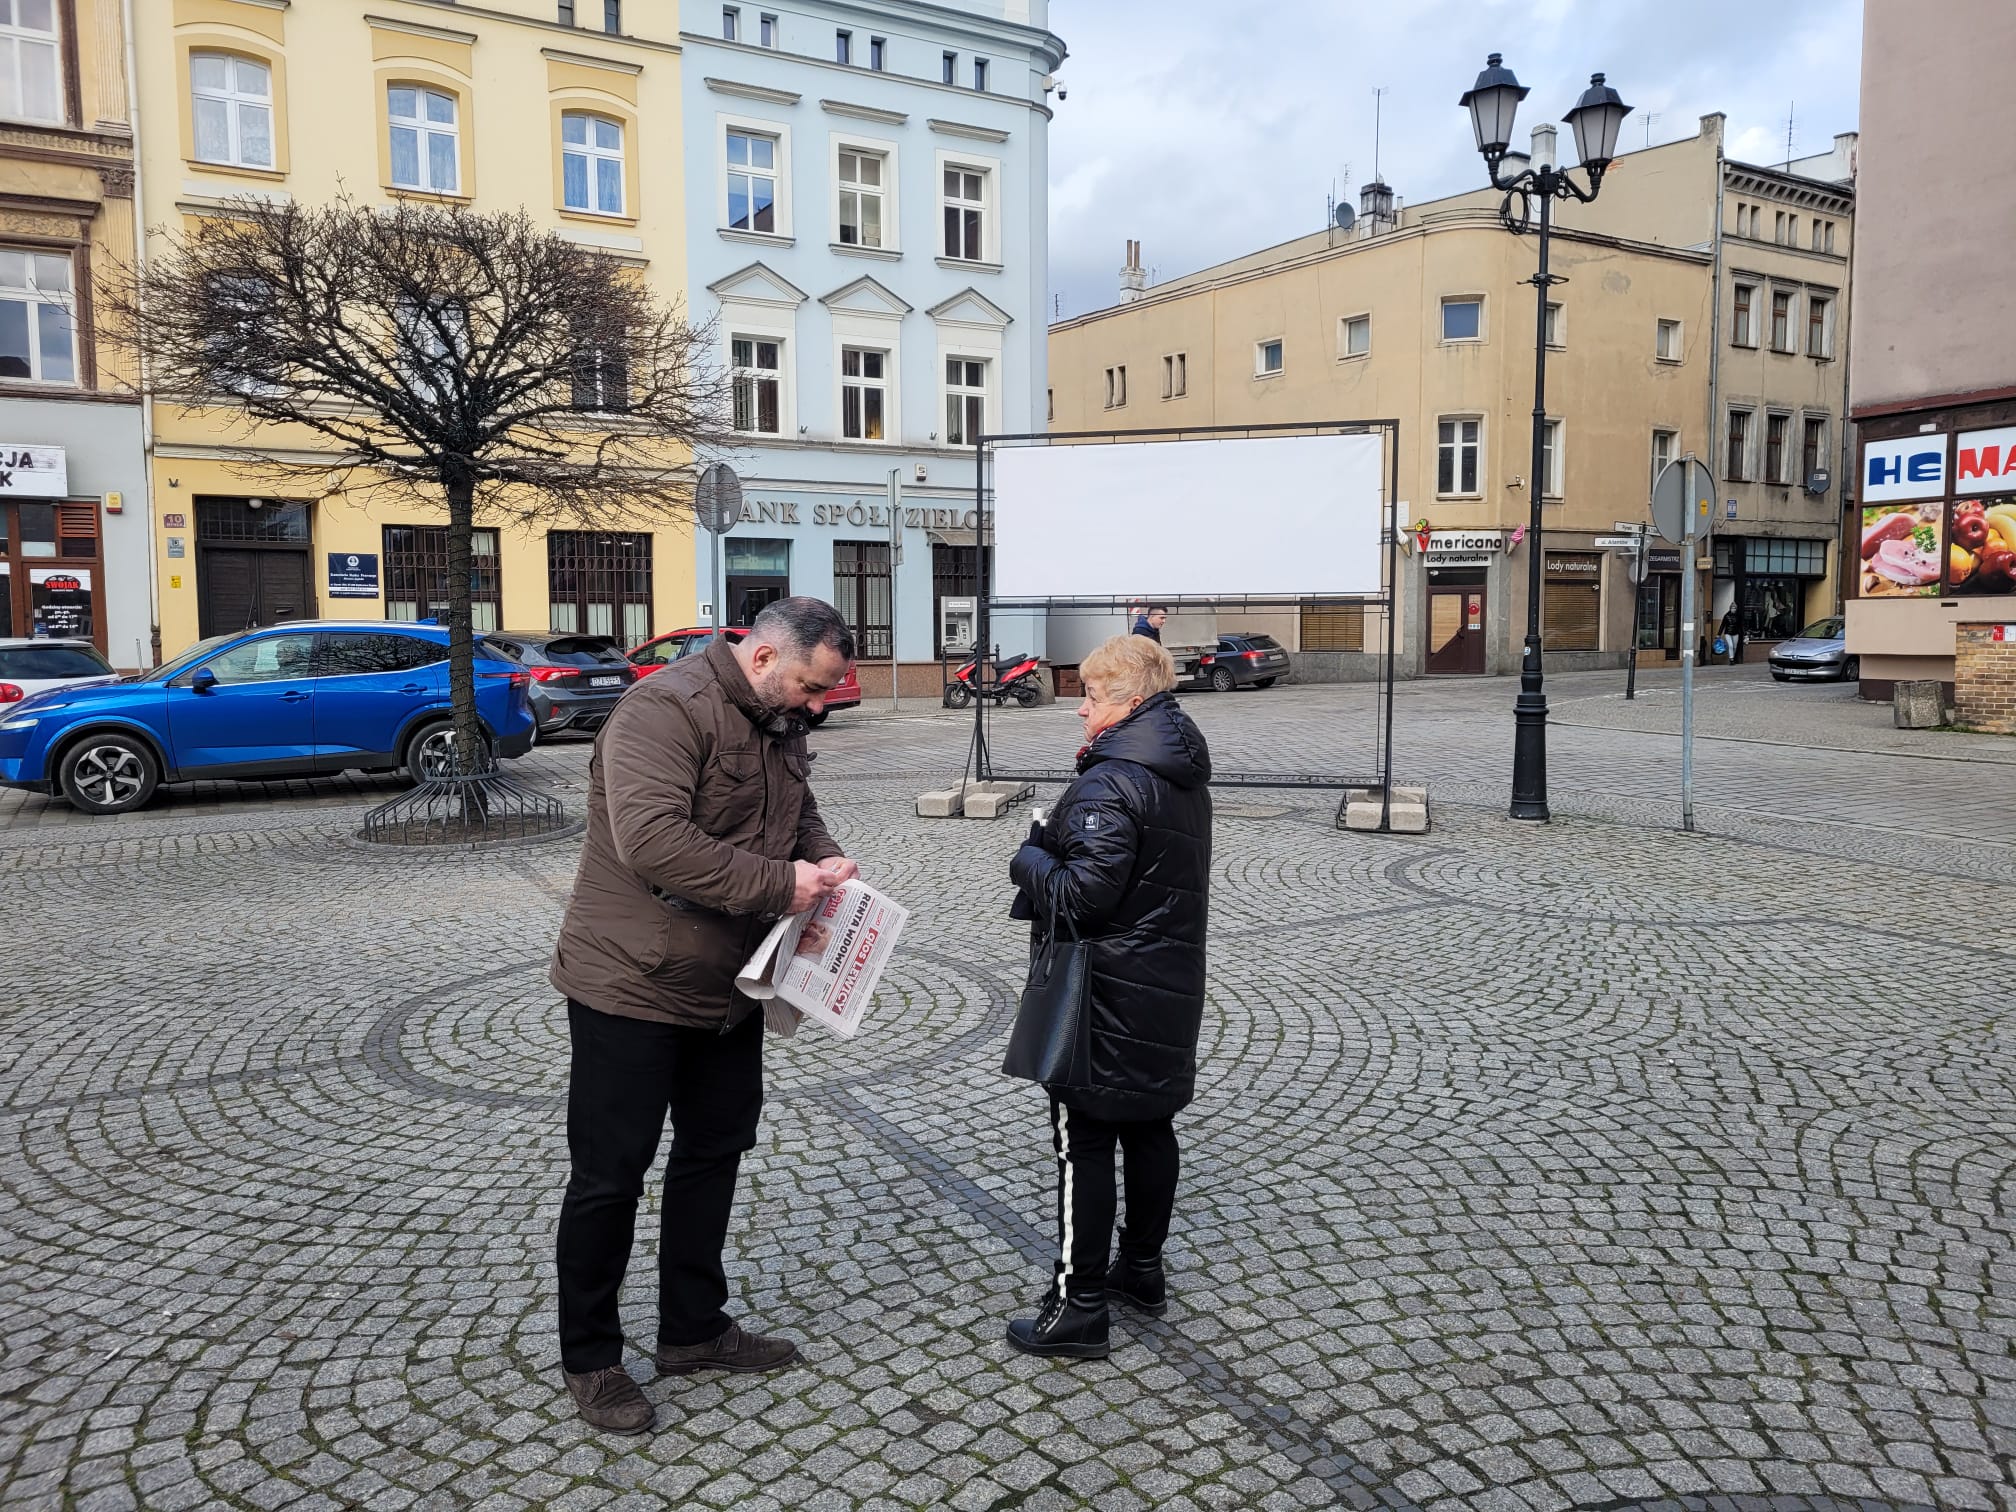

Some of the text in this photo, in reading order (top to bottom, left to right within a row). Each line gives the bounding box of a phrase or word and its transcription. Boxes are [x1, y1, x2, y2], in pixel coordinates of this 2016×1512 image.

[0, 451, 34, 468] JA
[167, 515, 182, 523] 10
[737, 500, 995, 530] ANK SPÓŁZIELC
[1426, 552, 1489, 564] Lody naturalne
[1547, 559, 1598, 573] Lody naturalne
[851, 892, 871, 927] RENTA
[830, 928, 856, 974] WDOWIA
